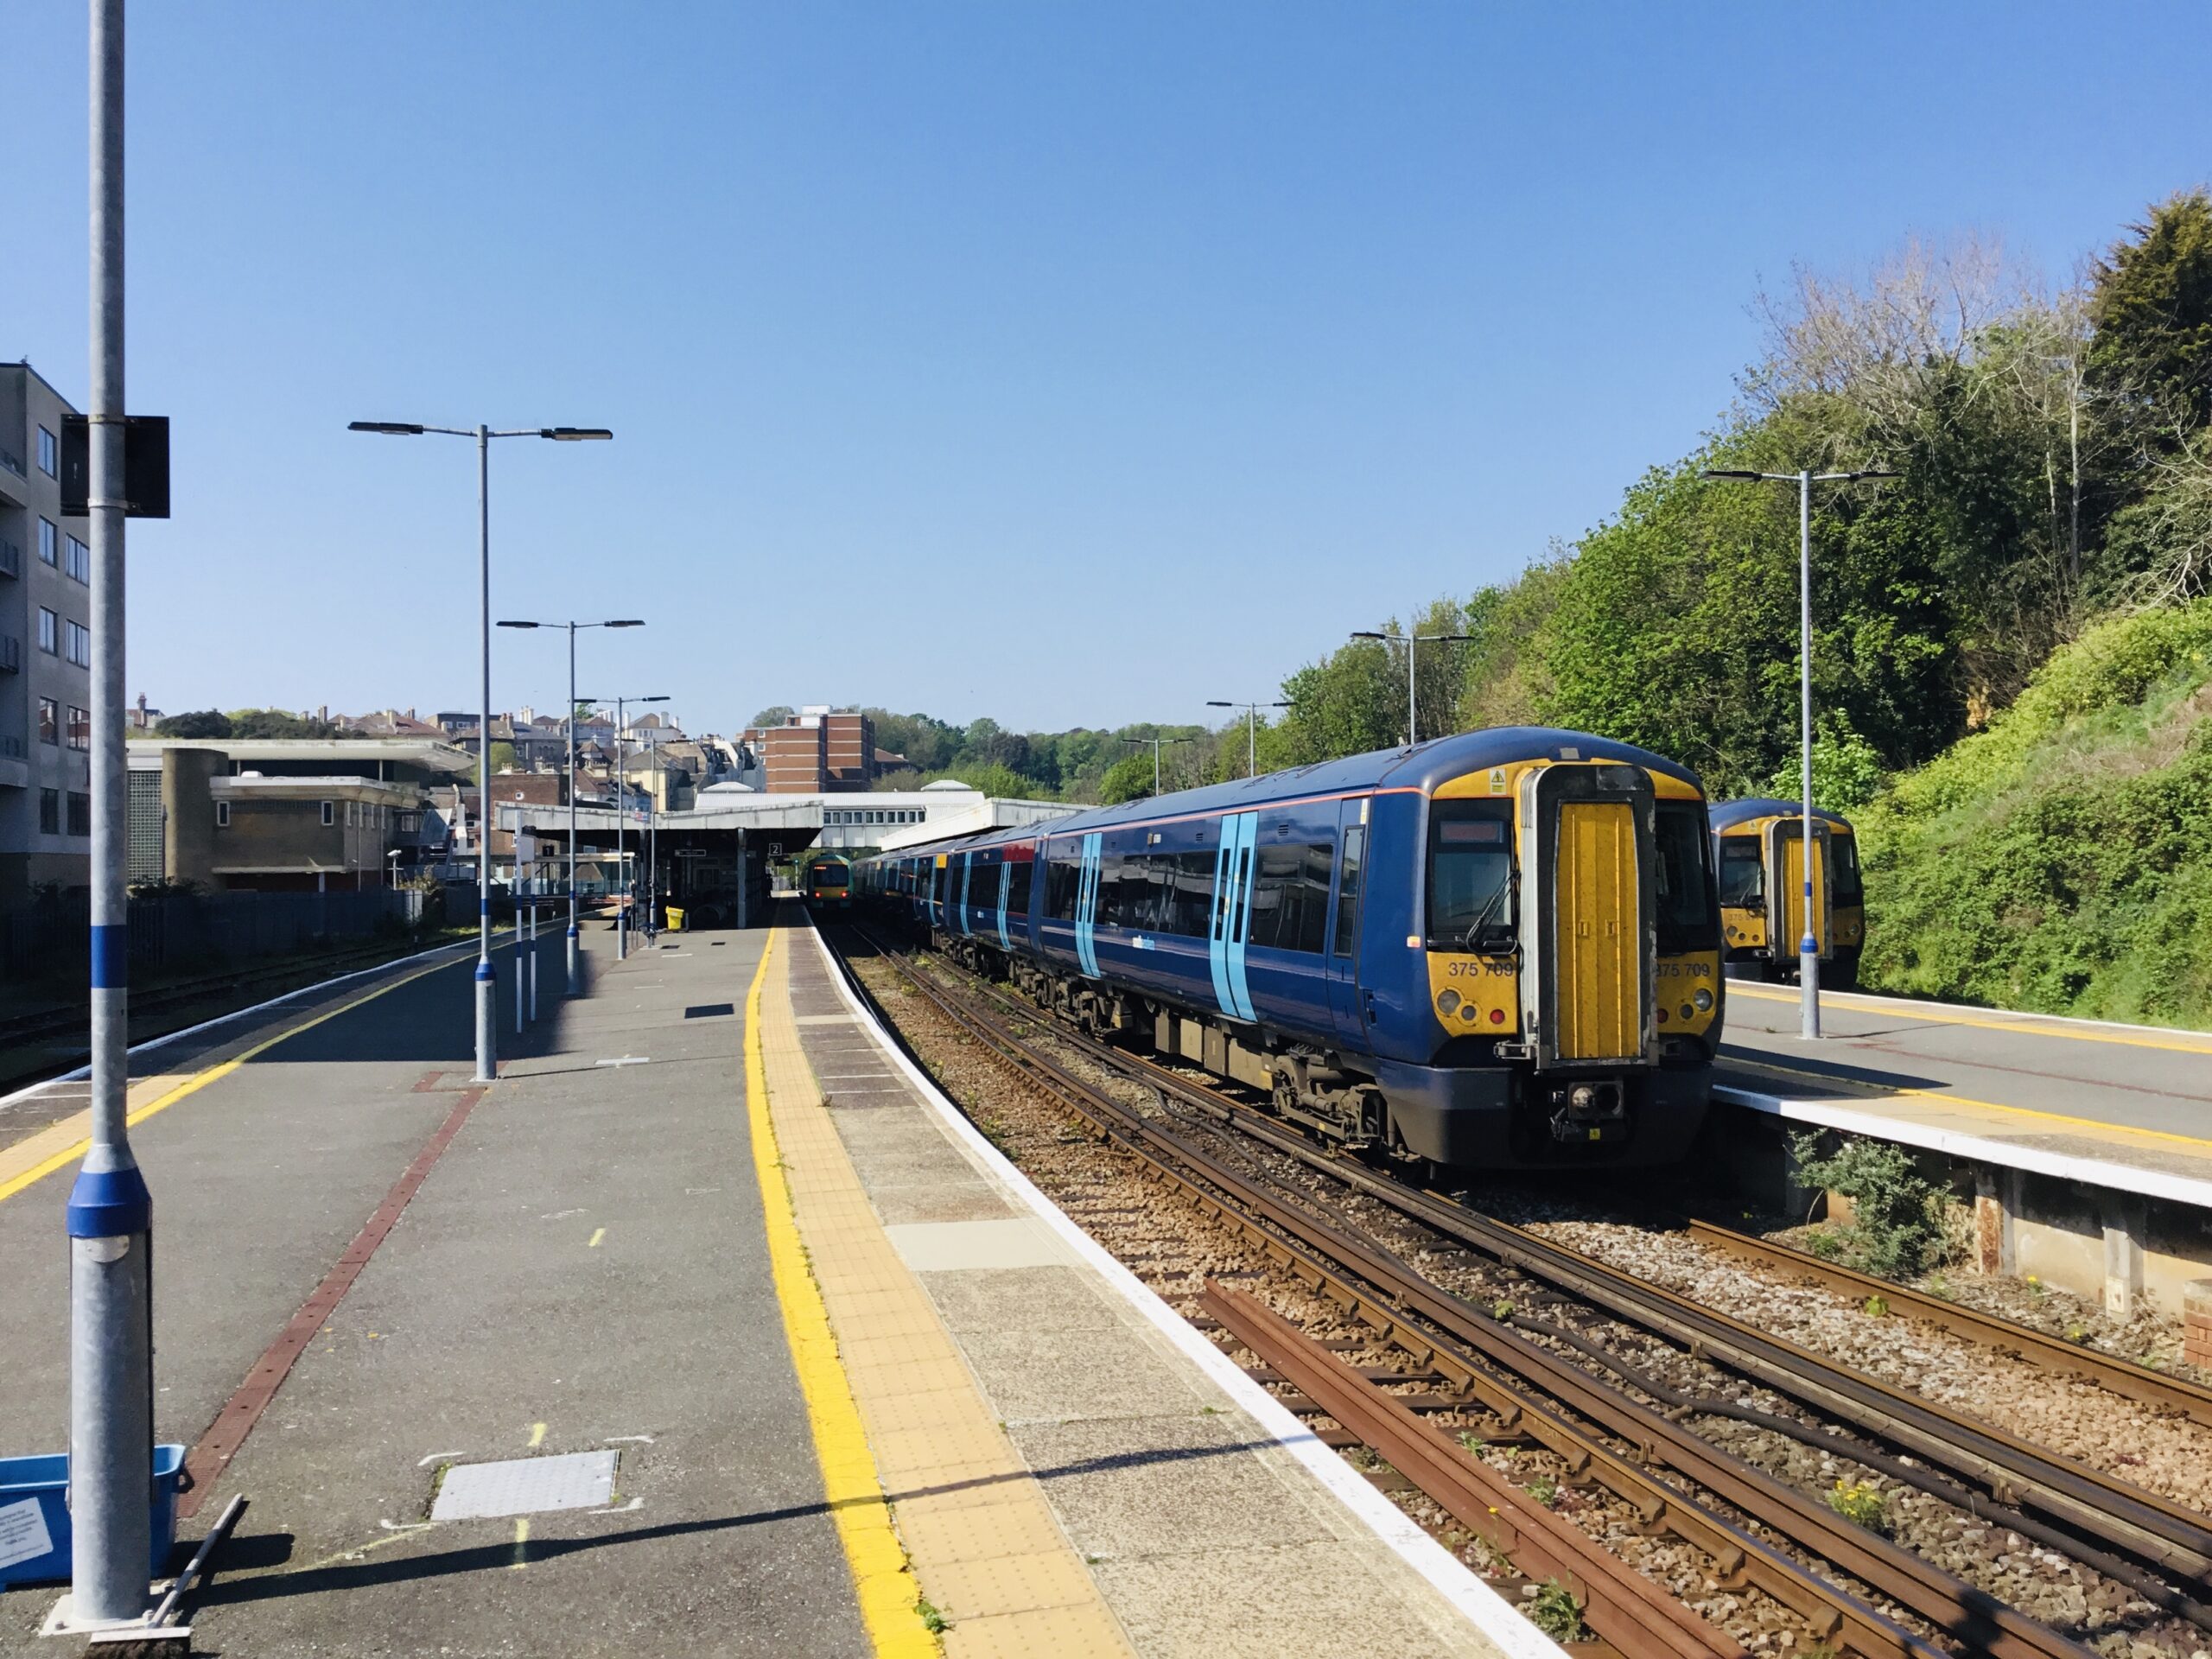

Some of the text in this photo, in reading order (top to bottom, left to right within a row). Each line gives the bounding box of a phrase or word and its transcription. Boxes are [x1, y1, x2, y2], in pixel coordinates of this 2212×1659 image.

[1449, 963, 1513, 976] 375 709
[1684, 963, 1710, 976] 709
